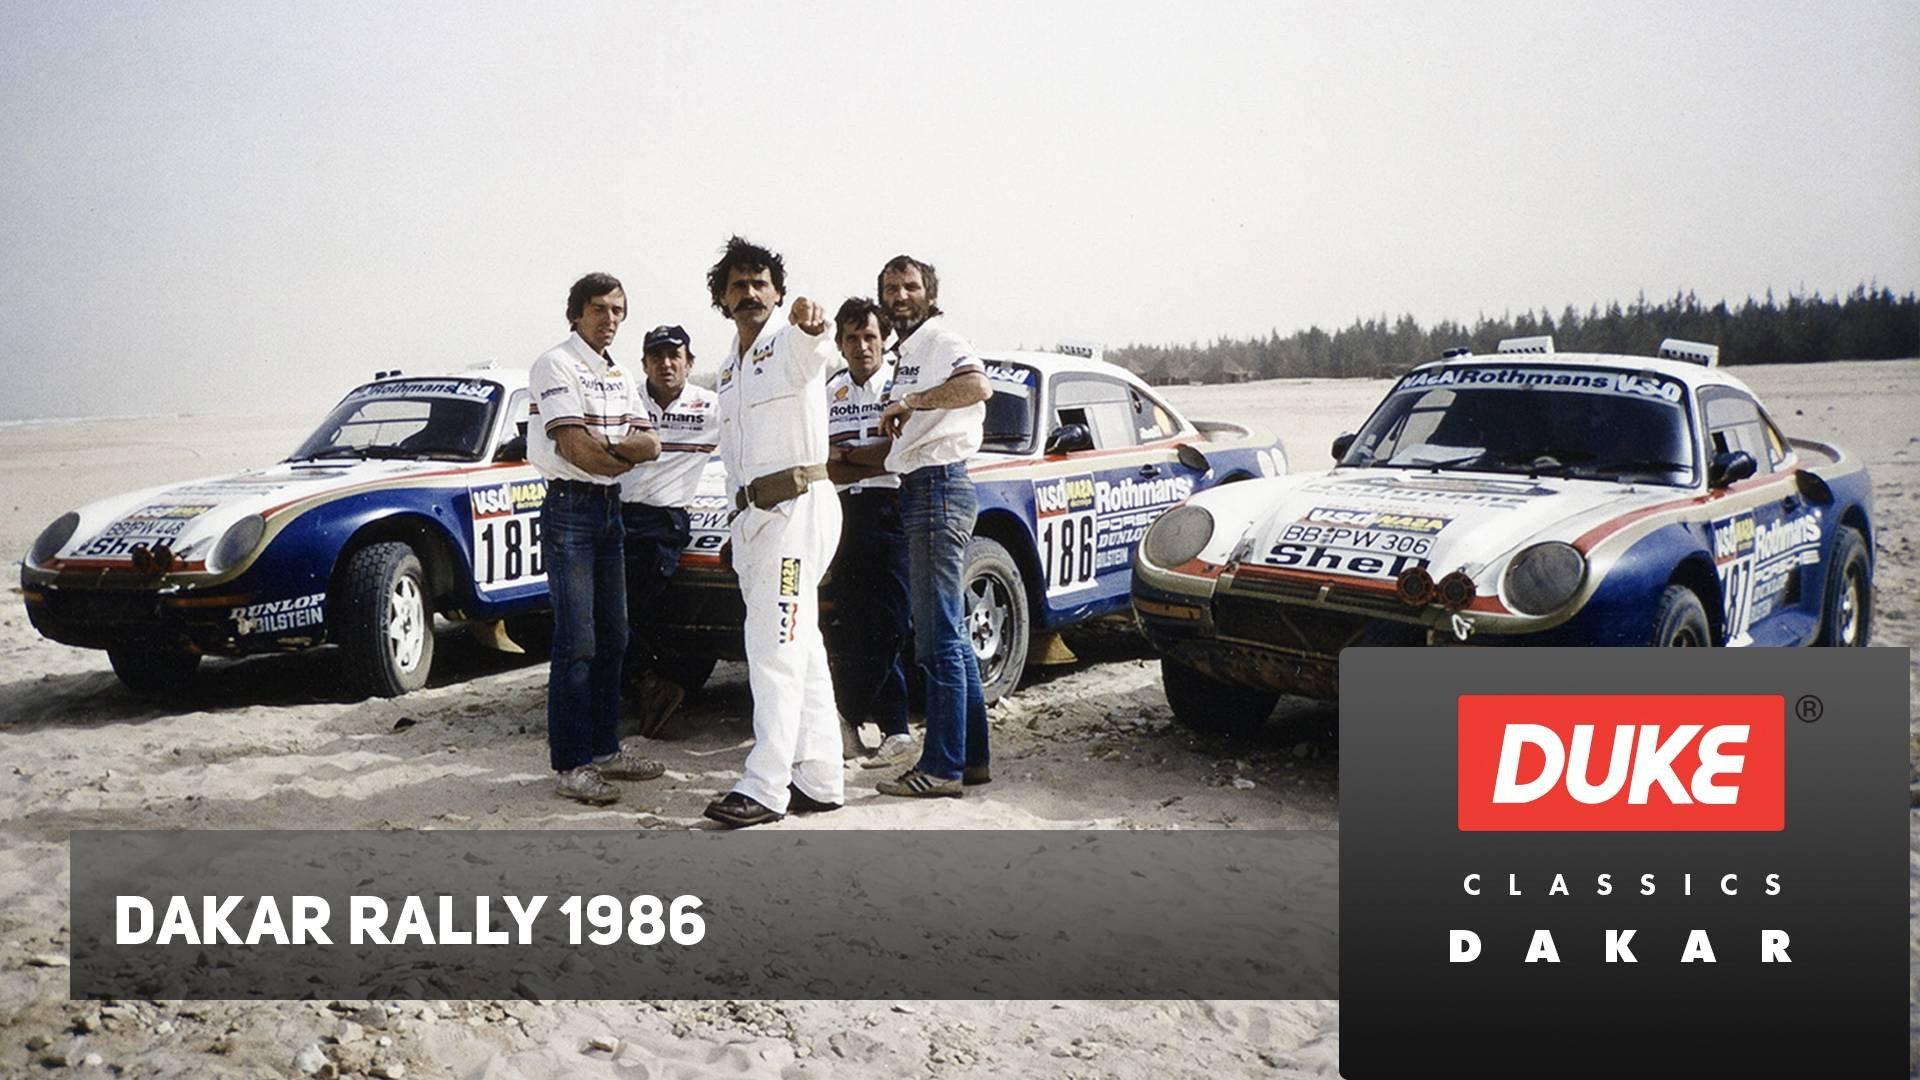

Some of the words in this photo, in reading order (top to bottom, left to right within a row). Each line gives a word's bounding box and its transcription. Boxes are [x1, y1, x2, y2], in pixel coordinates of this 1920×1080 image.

[1457, 369, 1609, 388] Rothmans
[1095, 476, 1193, 514] Rothmans
[1097, 512, 1162, 533] PORSC
[1098, 526, 1147, 548] DUNLO
[482, 519, 544, 584] 185
[1044, 516, 1093, 591] 186
[229, 592, 326, 619] DUNLOP
[255, 606, 323, 633] BILSTEIN
